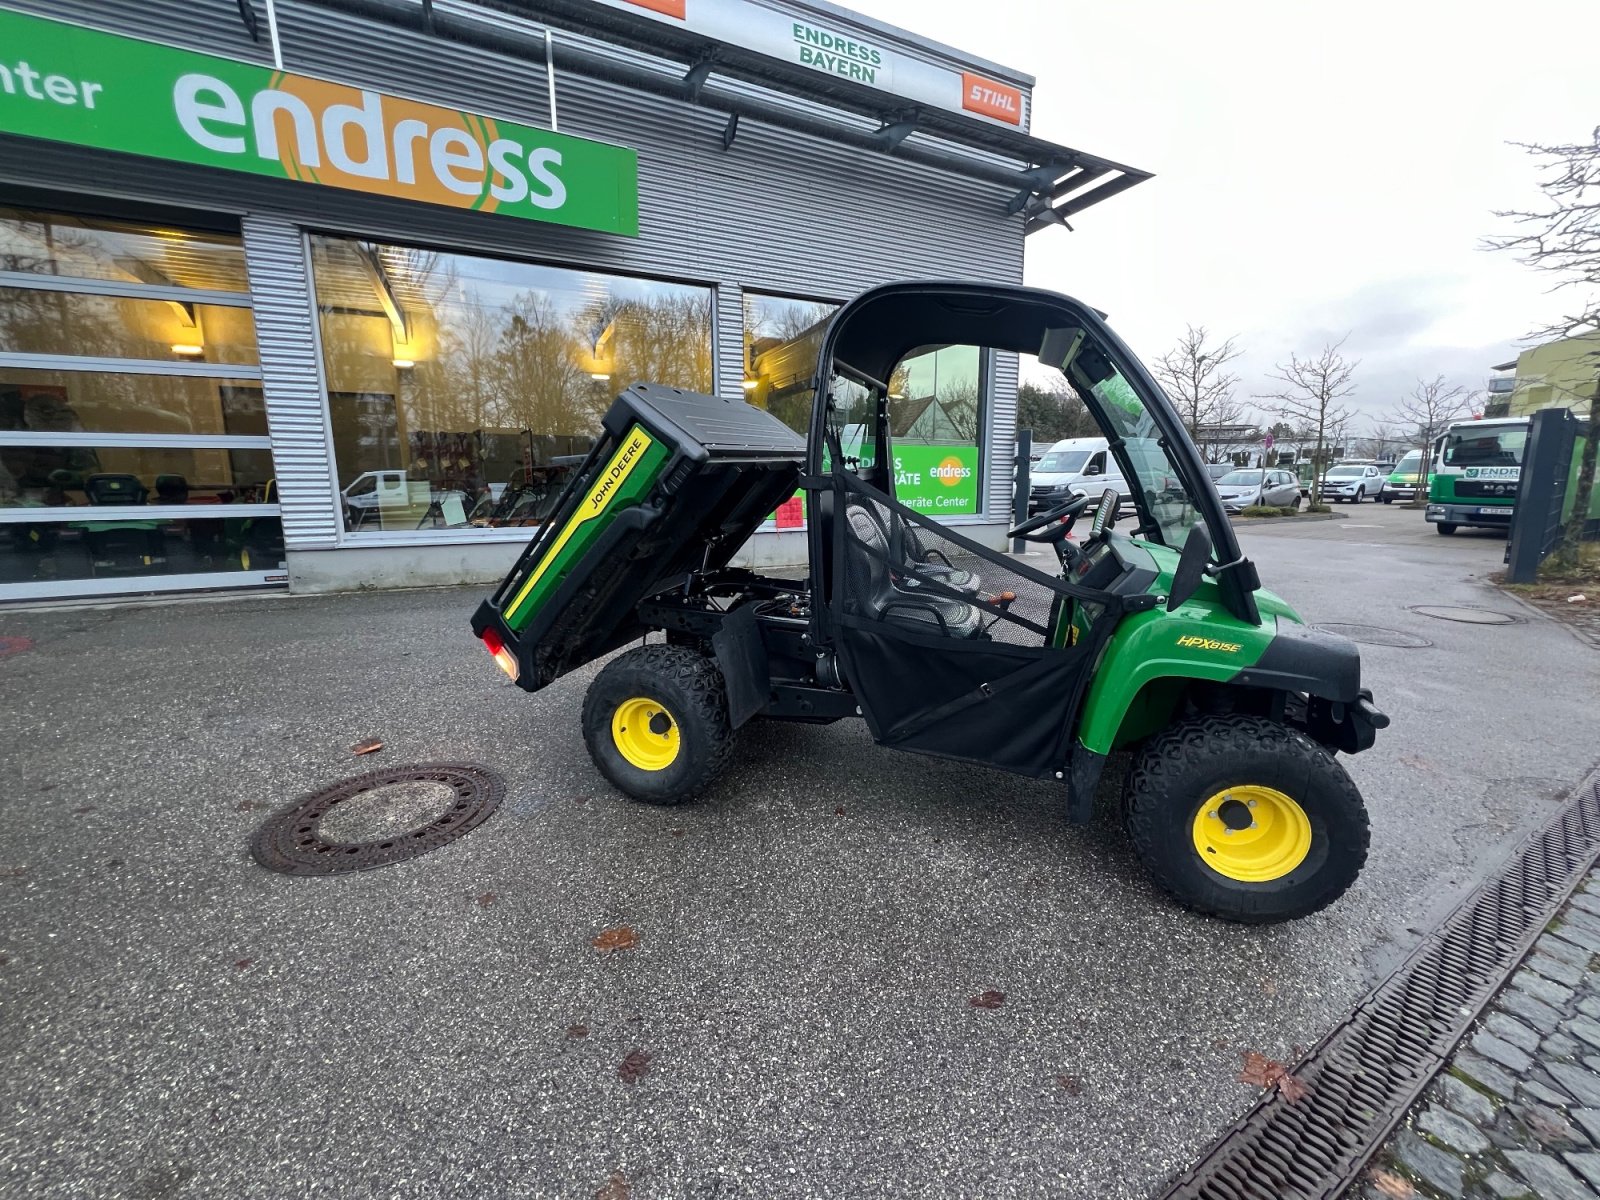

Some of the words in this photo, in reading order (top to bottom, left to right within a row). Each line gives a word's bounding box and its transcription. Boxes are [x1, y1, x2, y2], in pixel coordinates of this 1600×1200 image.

[793, 23, 882, 65] ENDRESS
[0, 61, 104, 109] nter
[800, 46, 876, 84] BAYERN
[970, 85, 1016, 112] STIHL
[173, 73, 567, 210] endress
[591, 478, 615, 510] JOHN
[610, 438, 642, 480] DEERE
[929, 465, 971, 478] endress
[935, 496, 969, 507] Center
